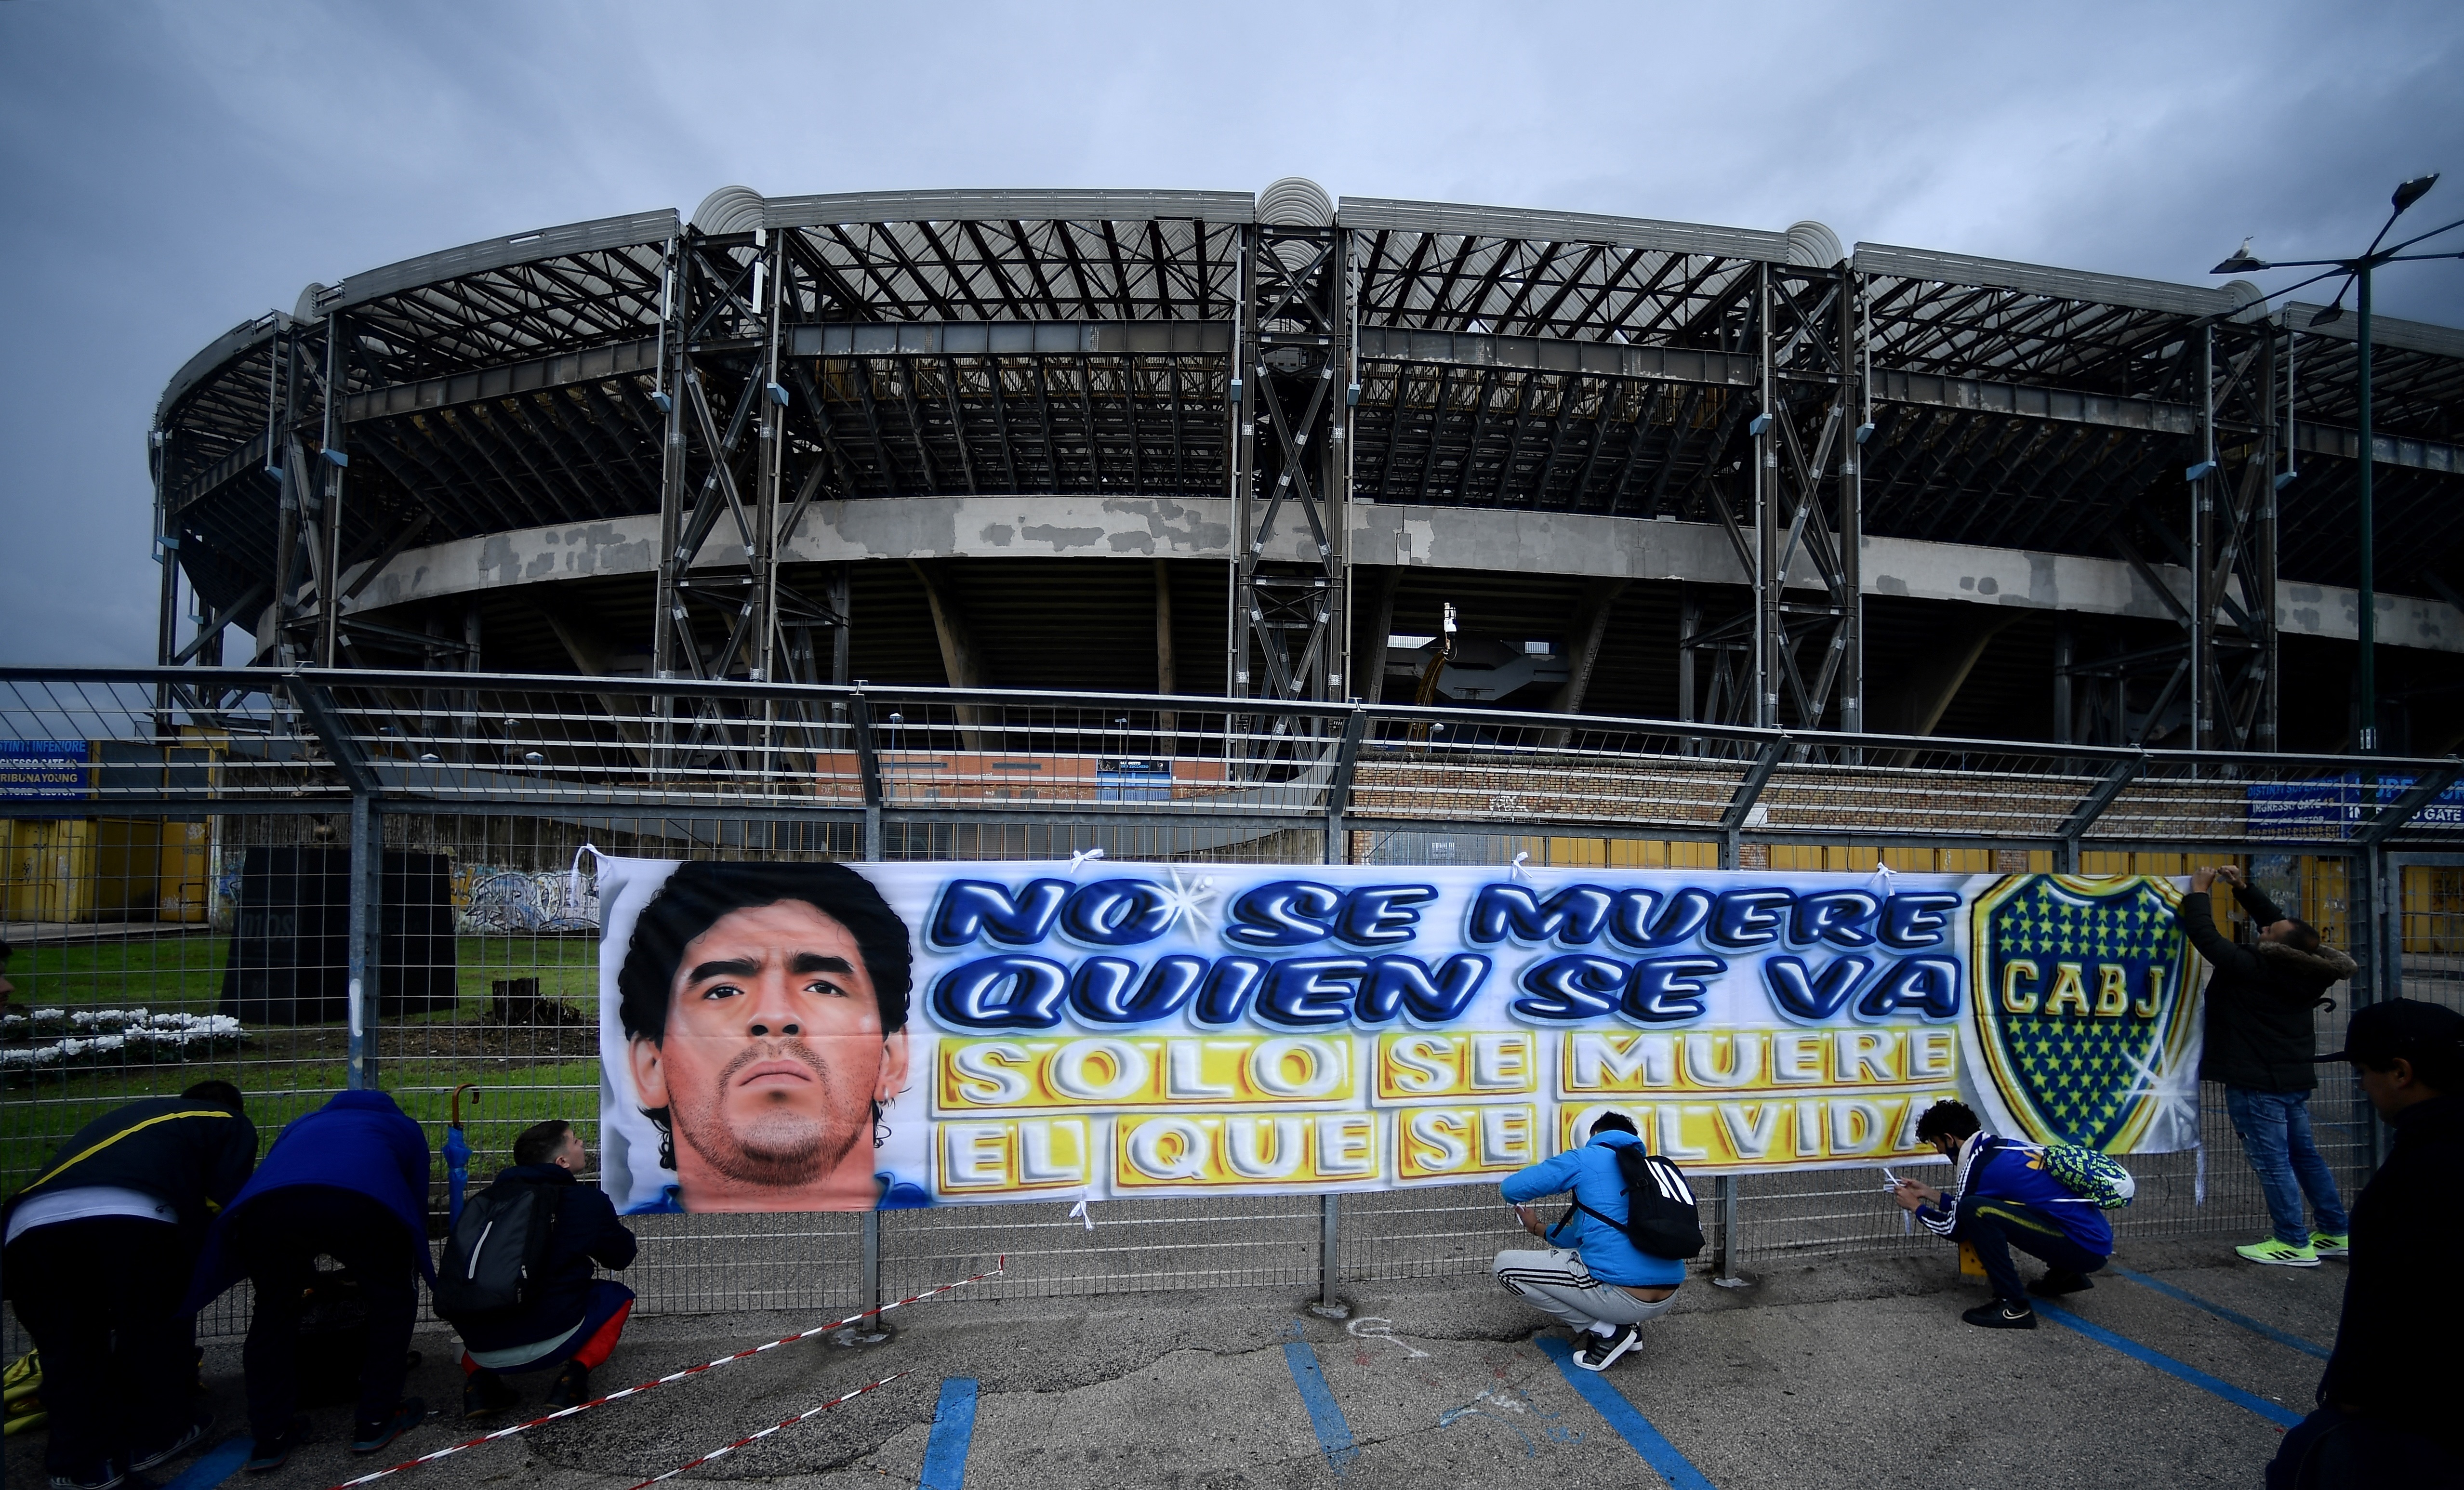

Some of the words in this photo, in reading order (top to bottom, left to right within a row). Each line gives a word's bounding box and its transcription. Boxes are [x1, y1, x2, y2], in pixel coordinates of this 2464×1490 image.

[33, 740, 86, 752] INFERIORE
[42, 773, 78, 782] YOUNG
[2297, 798, 2321, 810] GATE
[2424, 808, 2462, 821] GATE
[929, 878, 1177, 949] NO
[1223, 880, 1438, 949] SE
[1468, 883, 1962, 949] MUERE
[930, 953, 1493, 1030] QUIEN
[1513, 953, 1728, 1021] SE
[1765, 953, 1961, 1019] VA
[2002, 958, 2165, 1018] CABJ
[952, 1037, 1346, 1104] SOLO
[1388, 1031, 1533, 1092] SE
[1571, 1027, 1954, 1089] MUERE
[943, 1120, 1084, 1187] EL
[1125, 1113, 1372, 1180] QUE
[1410, 1104, 1529, 1172] SE
